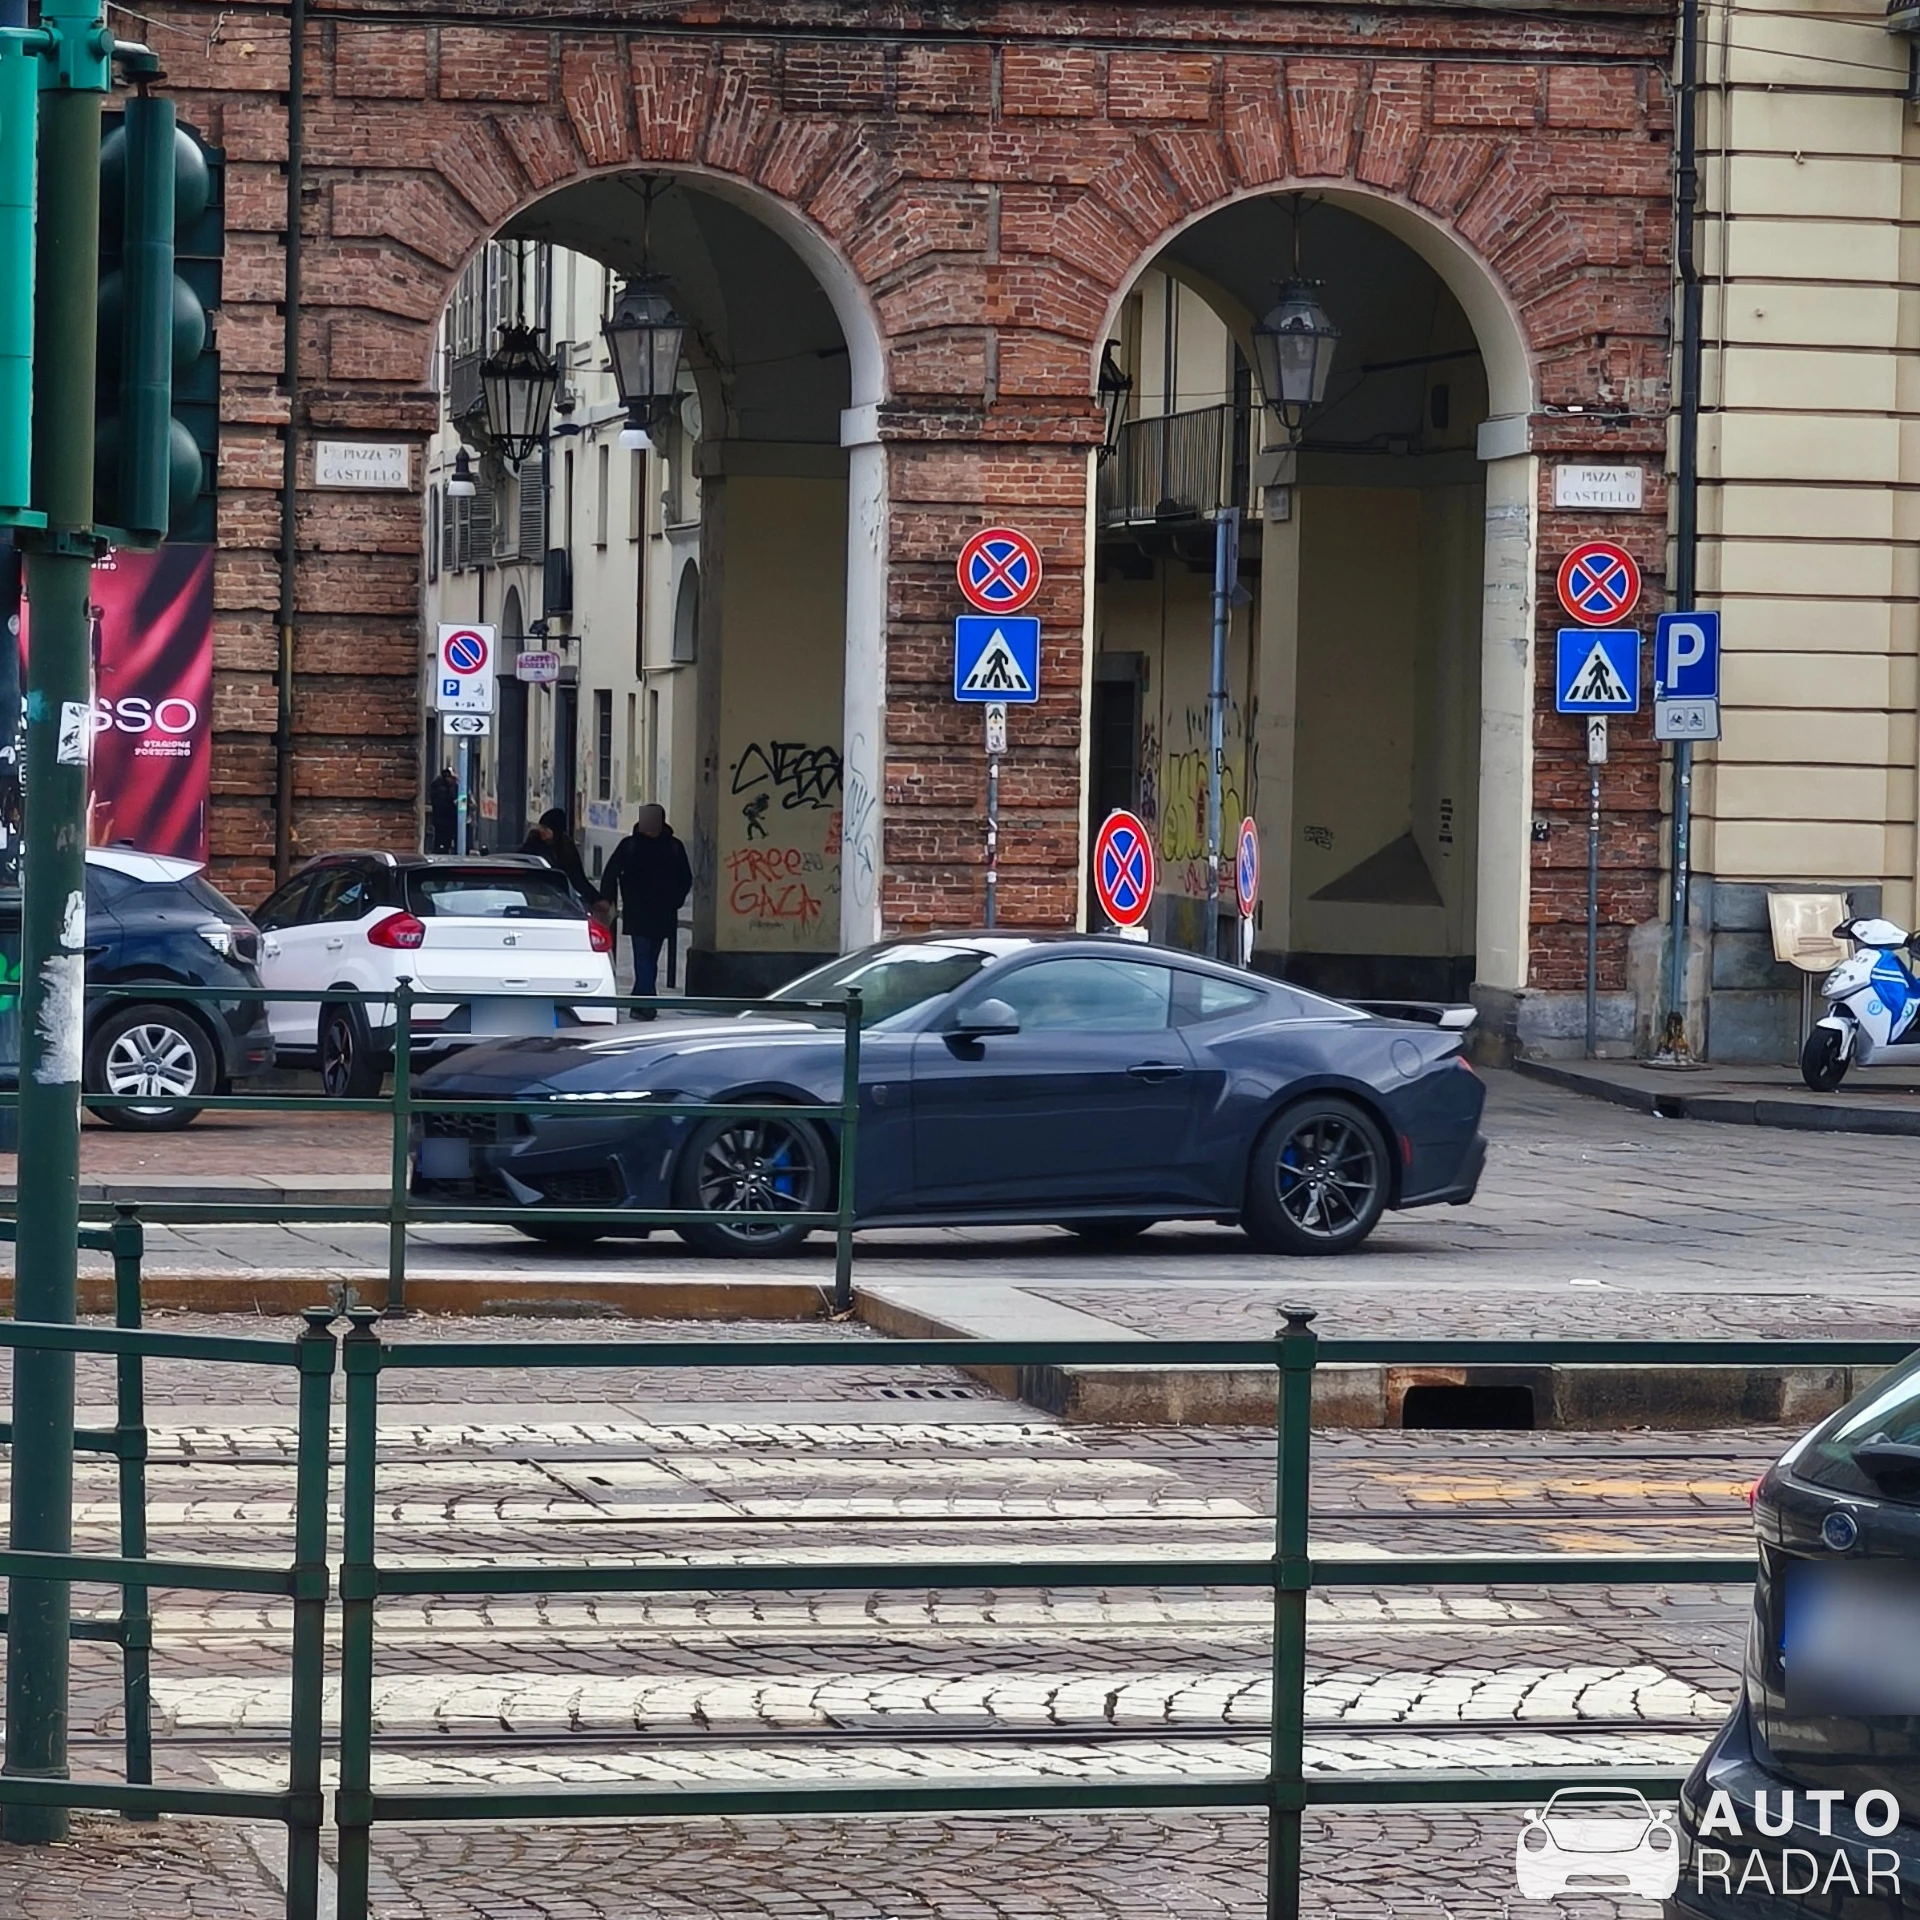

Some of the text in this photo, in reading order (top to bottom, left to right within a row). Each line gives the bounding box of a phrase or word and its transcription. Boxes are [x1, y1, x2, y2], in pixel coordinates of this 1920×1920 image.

[344, 449, 382, 460] PIAZZA
[323, 468, 402, 481] CASTELLO
[1581, 471, 1618, 482] PIAZZA
[1562, 490, 1636, 503] CASTELLO
[1667, 622, 1706, 689] P
[446, 681, 458, 695] P
